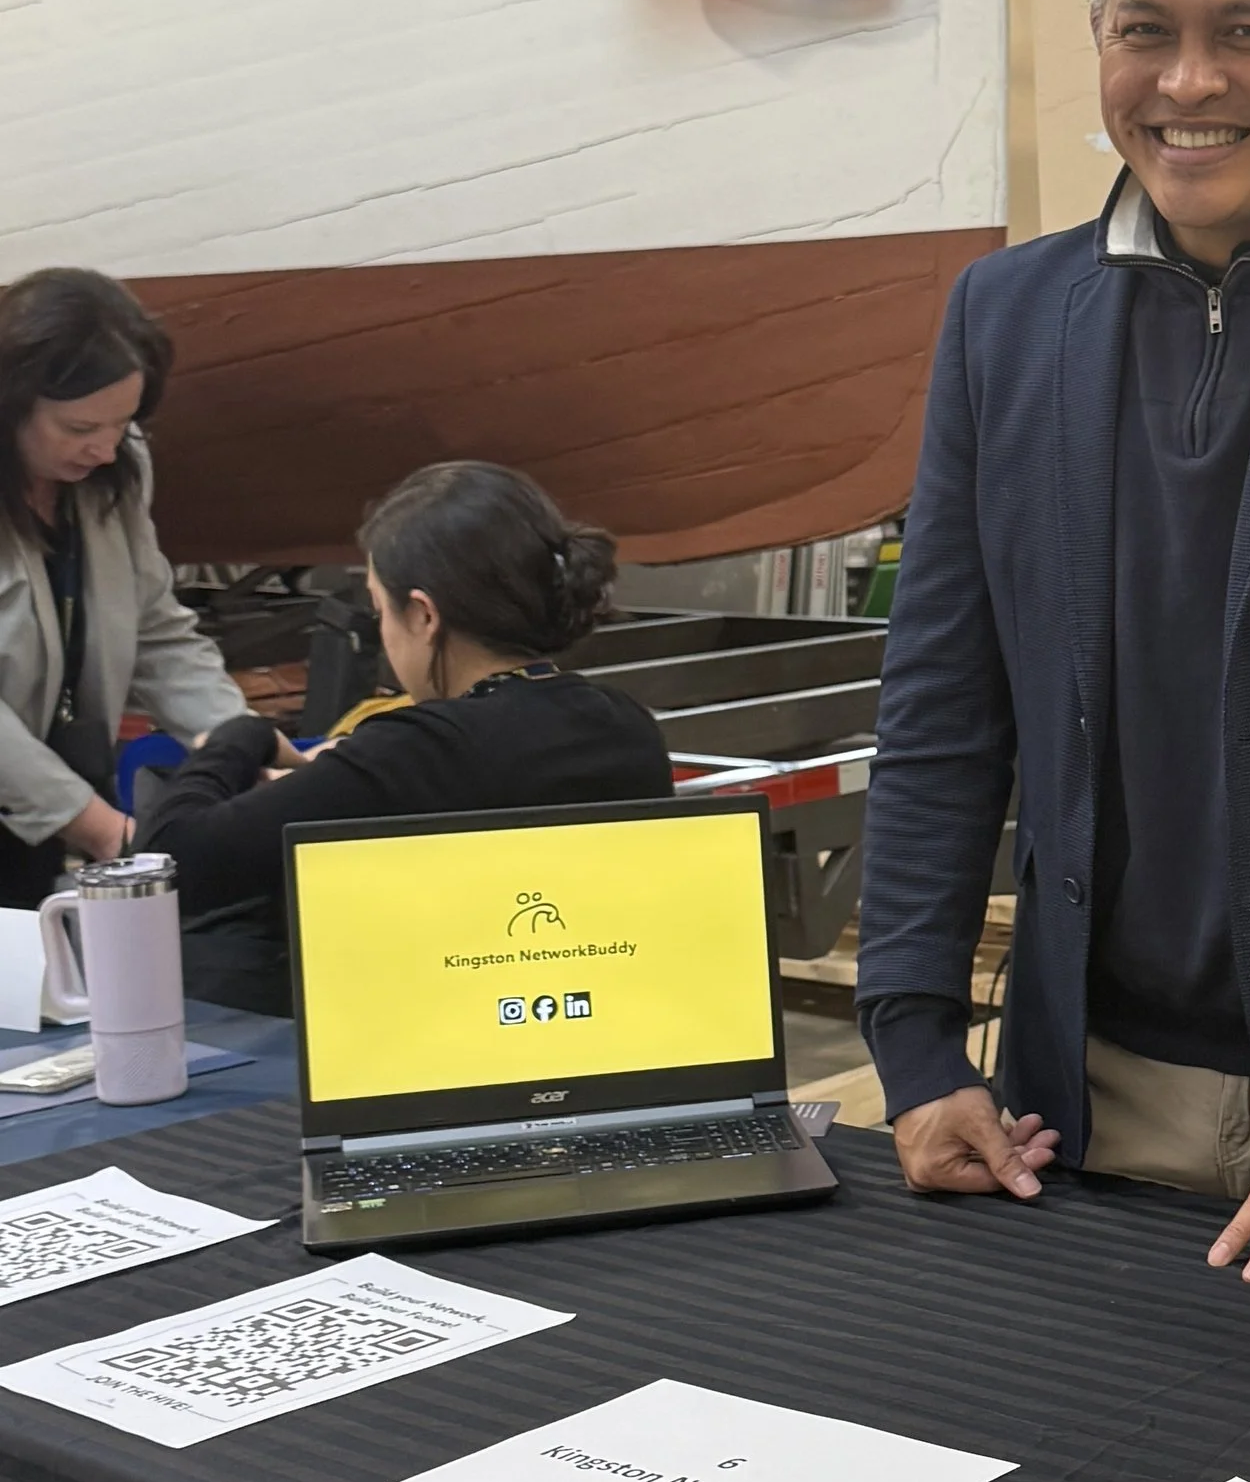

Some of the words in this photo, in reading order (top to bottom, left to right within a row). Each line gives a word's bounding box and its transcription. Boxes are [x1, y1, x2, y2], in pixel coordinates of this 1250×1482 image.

[444, 952, 515, 970] Kingston
[519, 940, 638, 962] NetworkBuddy
[531, 1090, 570, 1104] acer
[339, 1293, 380, 1305] Build
[358, 1282, 399, 1296] Build
[388, 1294, 426, 1305] your
[85, 1375, 127, 1389] JOIN
[121, 1385, 153, 1398] THE
[147, 1394, 193, 1412] HIVE!
[717, 1457, 748, 1470] 6
